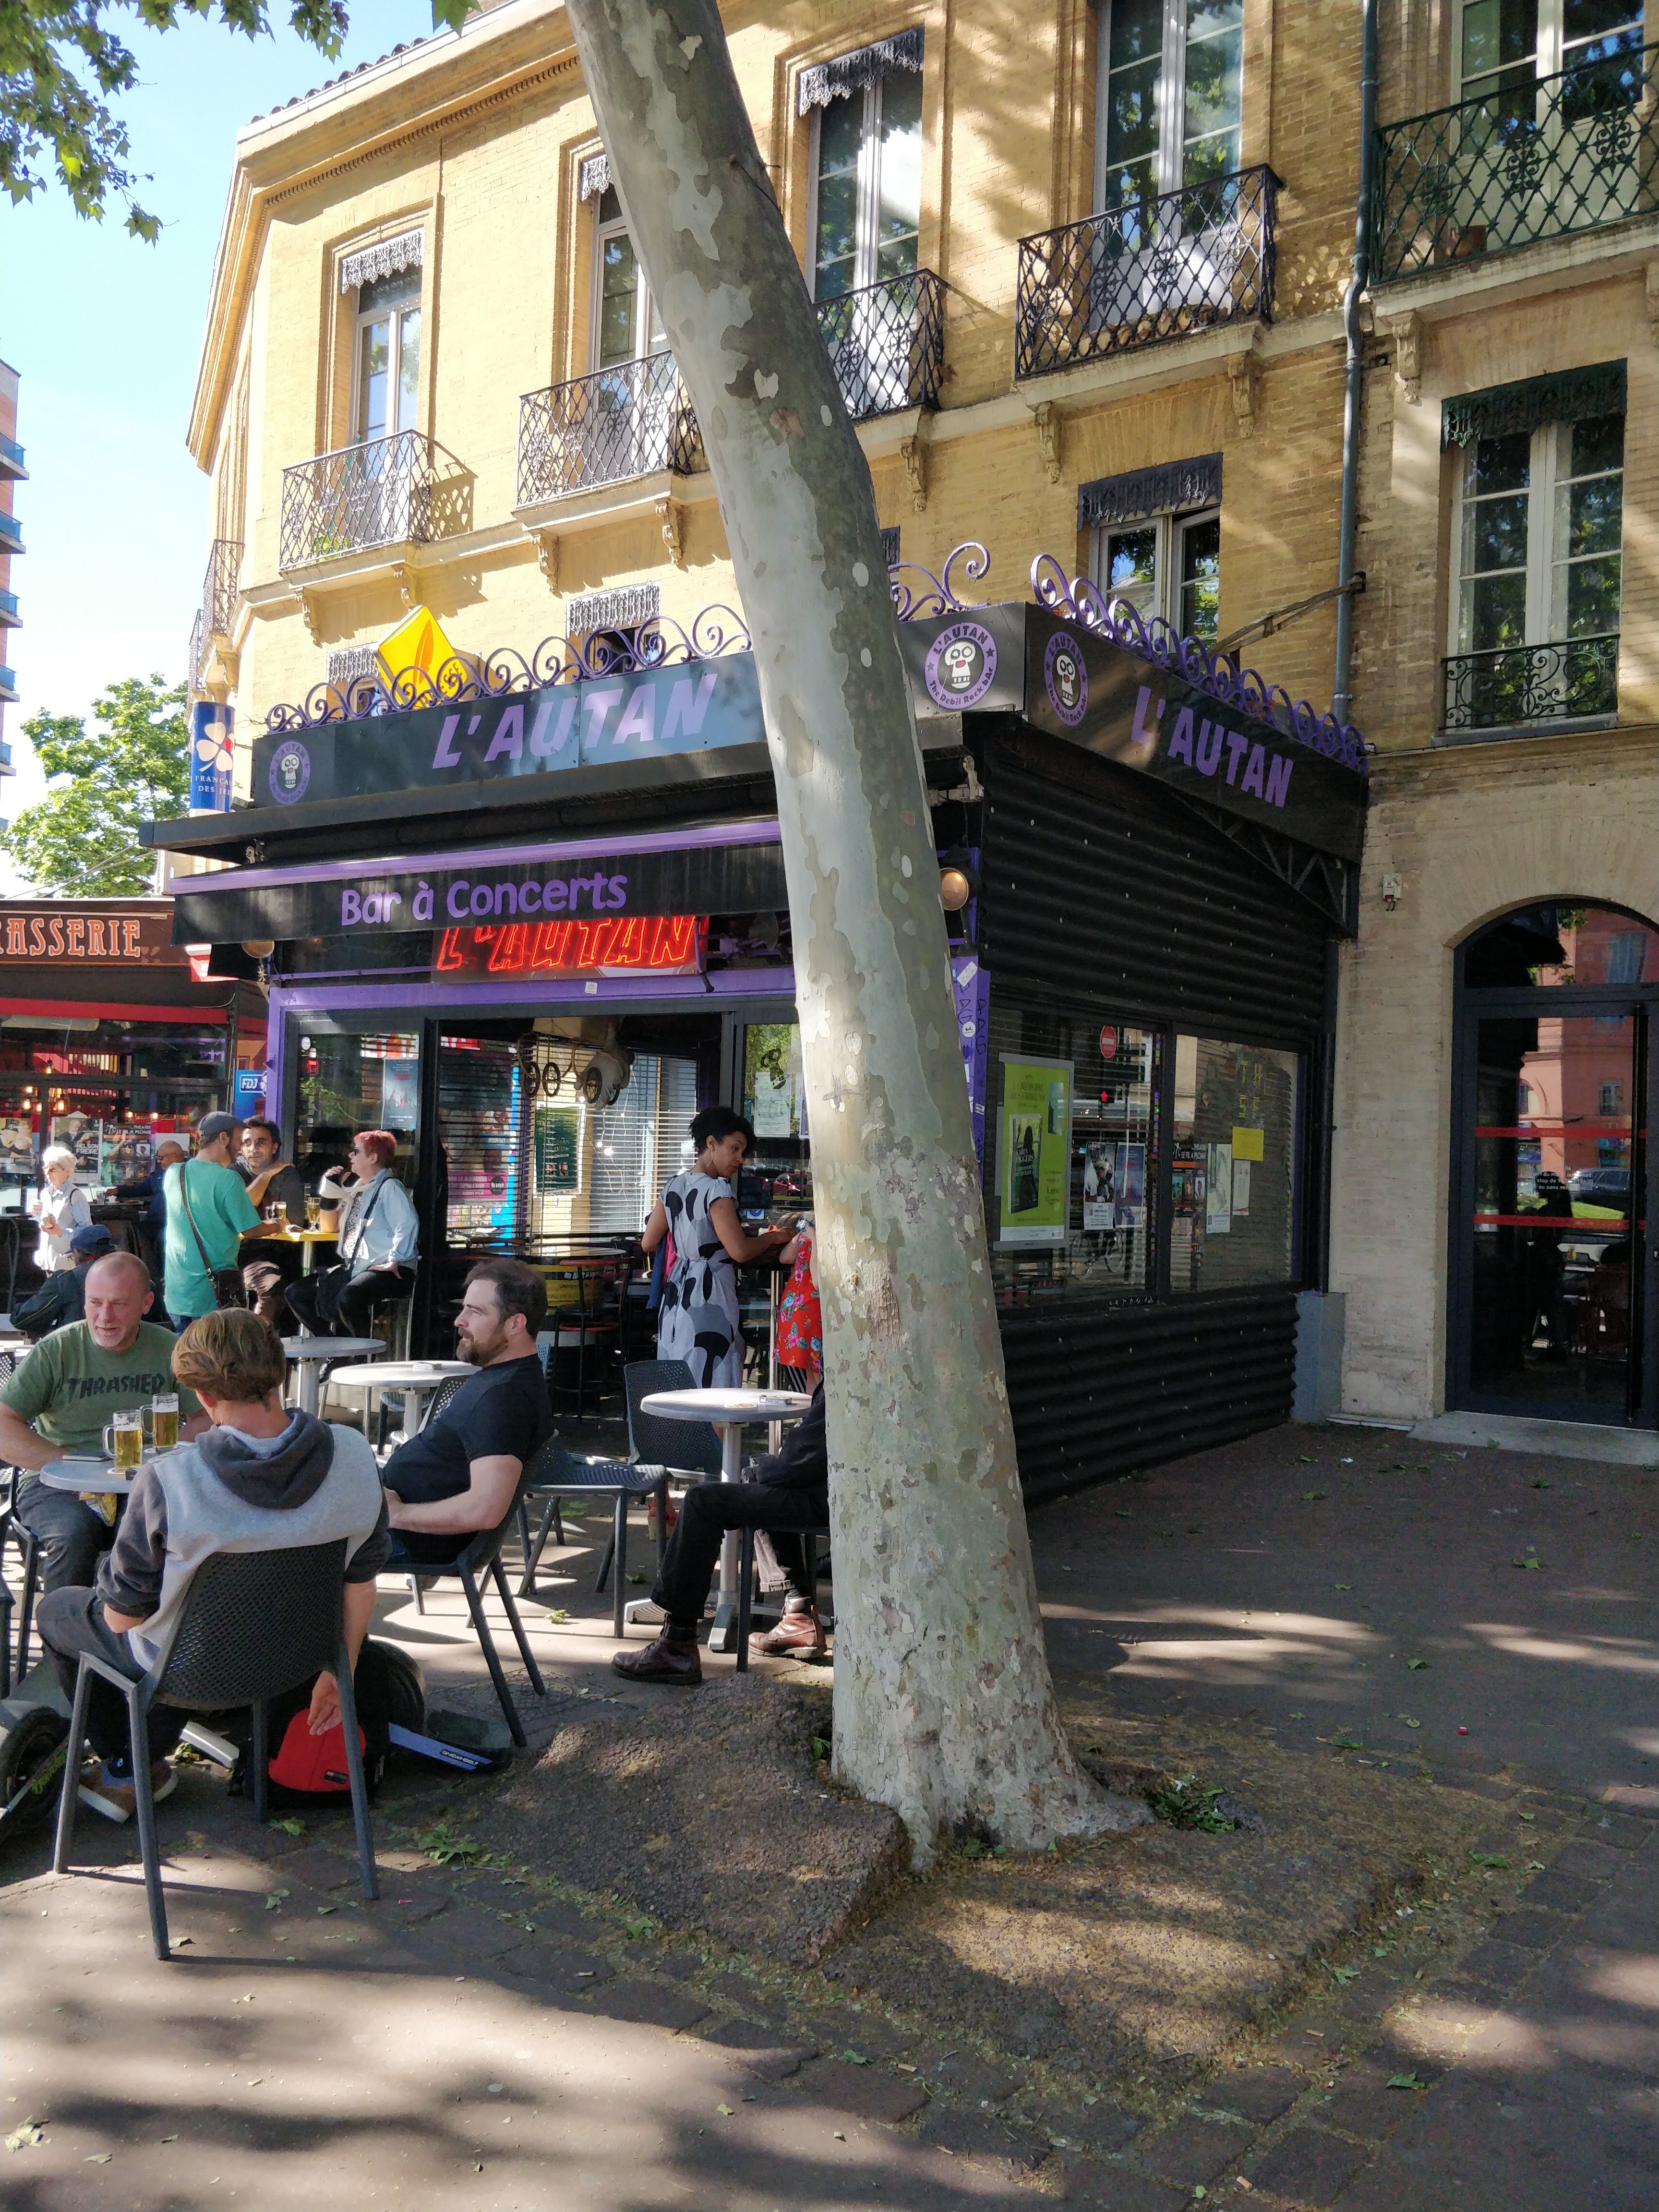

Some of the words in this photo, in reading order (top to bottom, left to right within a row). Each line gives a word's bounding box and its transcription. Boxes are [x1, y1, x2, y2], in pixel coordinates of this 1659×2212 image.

[933, 625, 988, 655] L'AUTAN
[1049, 636, 1082, 665] L'AUTAN
[929, 680, 940, 697] The
[964, 686, 983, 703] Rock
[433, 673, 718, 768] L'AUTAN
[1131, 685, 1293, 808] L'AUTAN
[341, 890, 402, 926] Bar
[413, 881, 433, 921] à
[447, 872, 628, 918] Concerts
[0, 917, 141, 958] ASSERIE
[437, 915, 696, 972] L'AUTAN
[241, 1078, 258, 1089] FDJ
